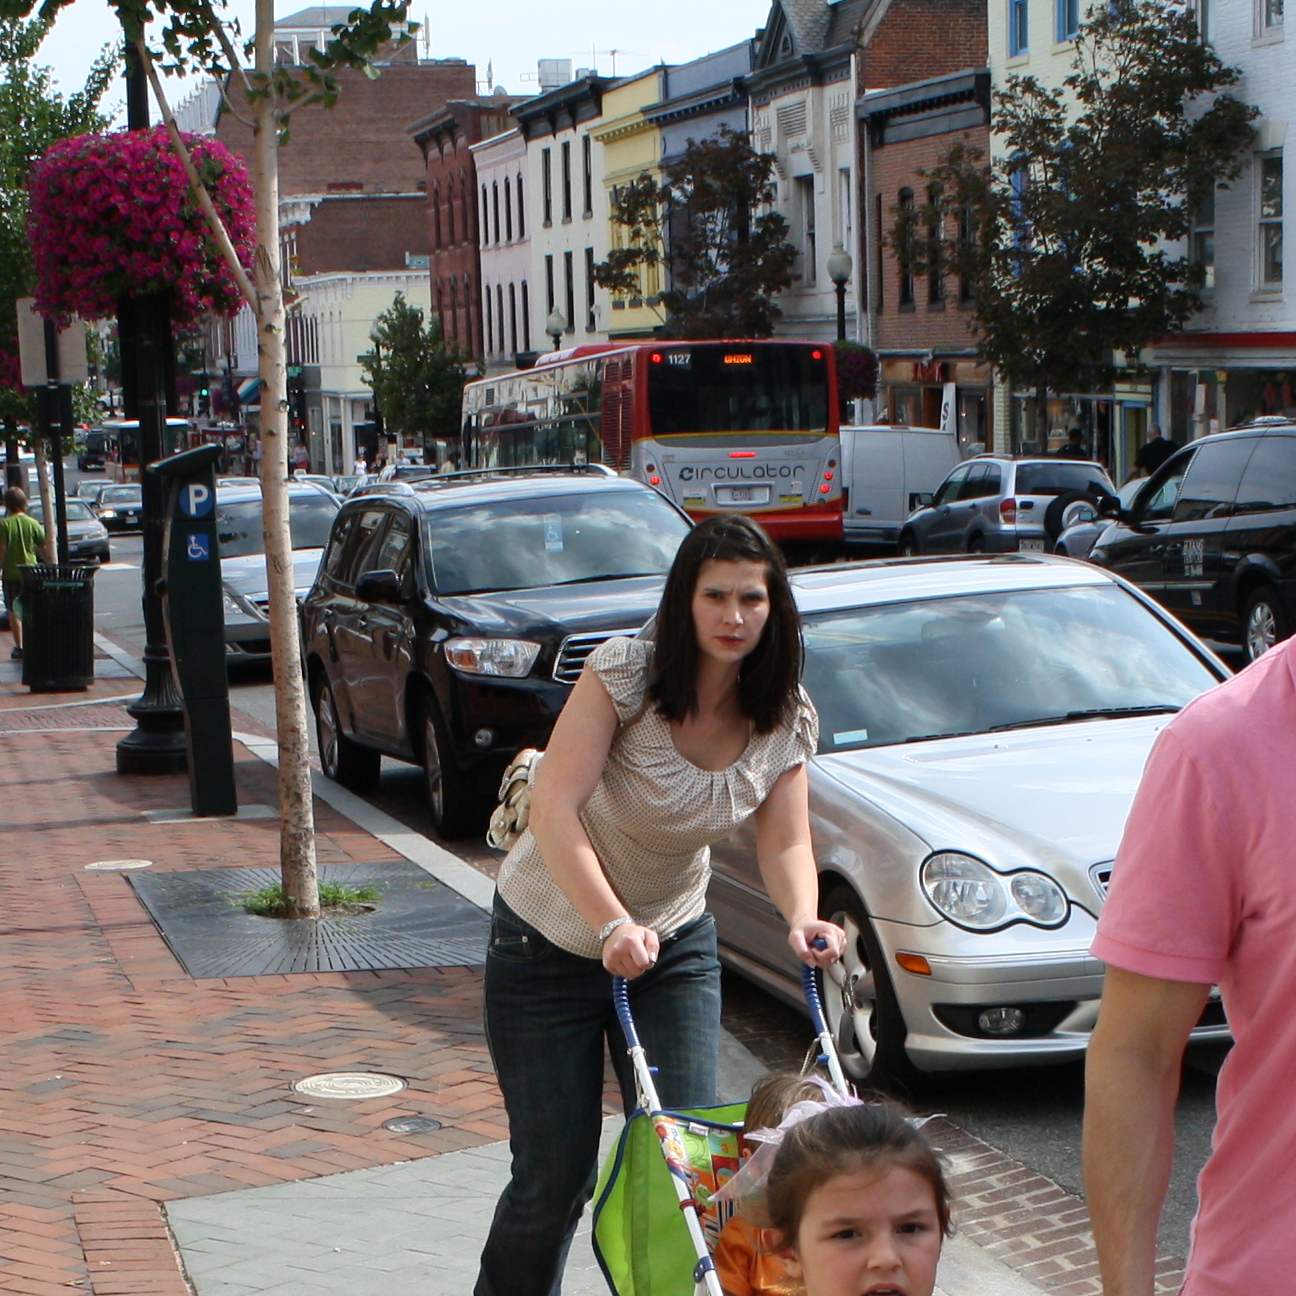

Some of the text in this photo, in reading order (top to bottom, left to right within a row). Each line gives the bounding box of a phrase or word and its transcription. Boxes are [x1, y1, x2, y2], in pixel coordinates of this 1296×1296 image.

[667, 354, 692, 365] 1127
[724, 354, 753, 364] UNION
[189, 484, 209, 515] P
